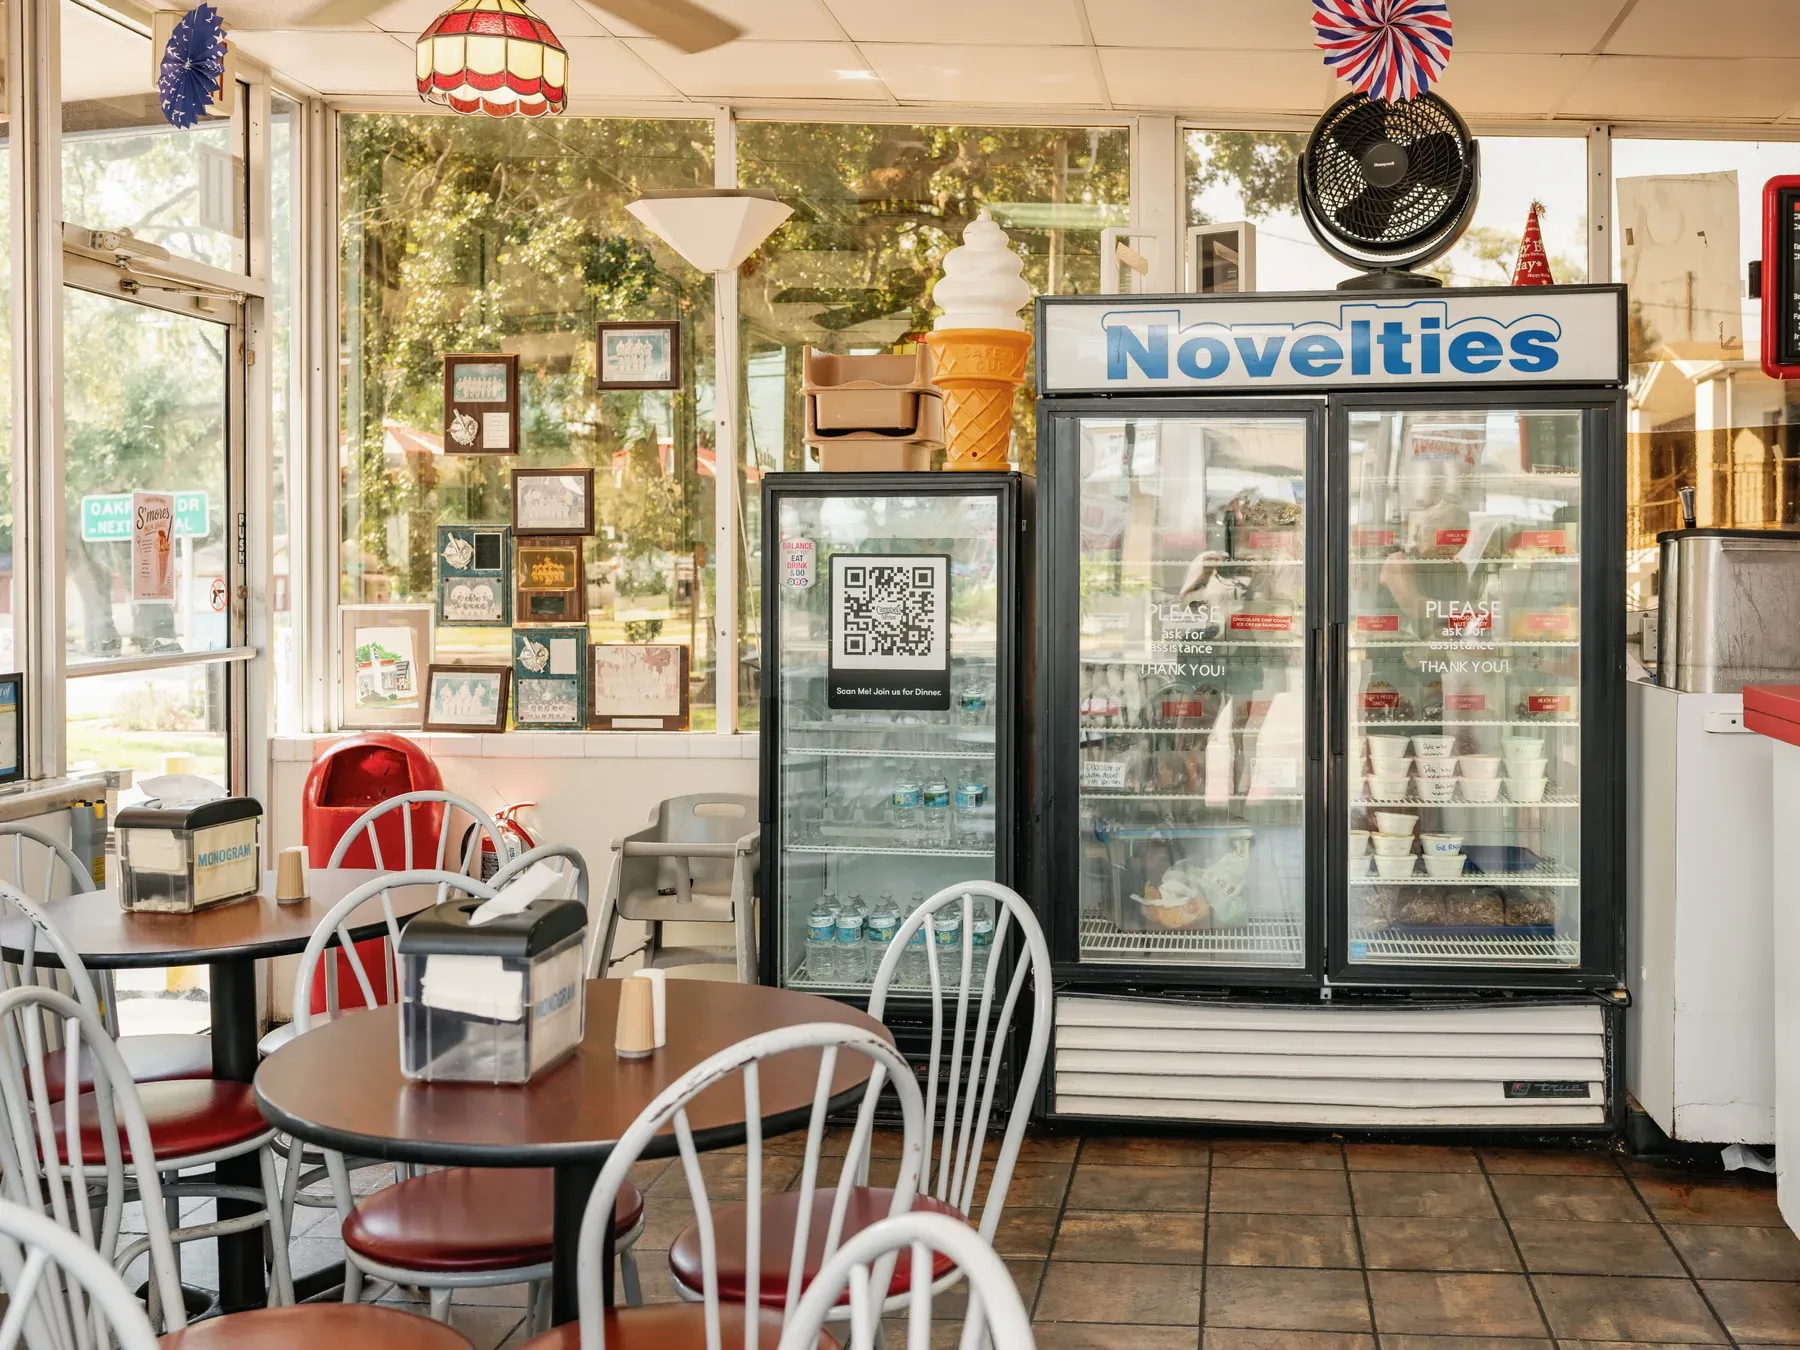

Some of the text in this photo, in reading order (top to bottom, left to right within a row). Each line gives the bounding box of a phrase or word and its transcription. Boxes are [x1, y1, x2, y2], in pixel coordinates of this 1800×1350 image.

[1105, 314, 1561, 381] Novelties
[177, 497, 200, 512] DR
[136, 505, 170, 530] S'mores
[782, 542, 813, 550] BALANCE
[791, 554, 804, 562] EAT
[786, 561, 808, 569] DRINK
[795, 569, 805, 577] DO
[1150, 603, 1221, 623] PLEASE
[1425, 600, 1502, 619] PLEASE
[1162, 628, 1205, 640] ask for
[1442, 625, 1463, 637] ask
[1150, 642, 1213, 655] assistance
[1430, 638, 1495, 651] assistance
[1140, 663, 1225, 677] THANK YOU!
[1419, 660, 1509, 674] THANK YOU!
[836, 687, 856, 695] Scan
[857, 687, 872, 695] Me!
[873, 687, 890, 696] Join
[902, 688, 914, 696] for
[915, 688, 942, 697] Dinner.
[197, 842, 252, 868] MONOGRAM
